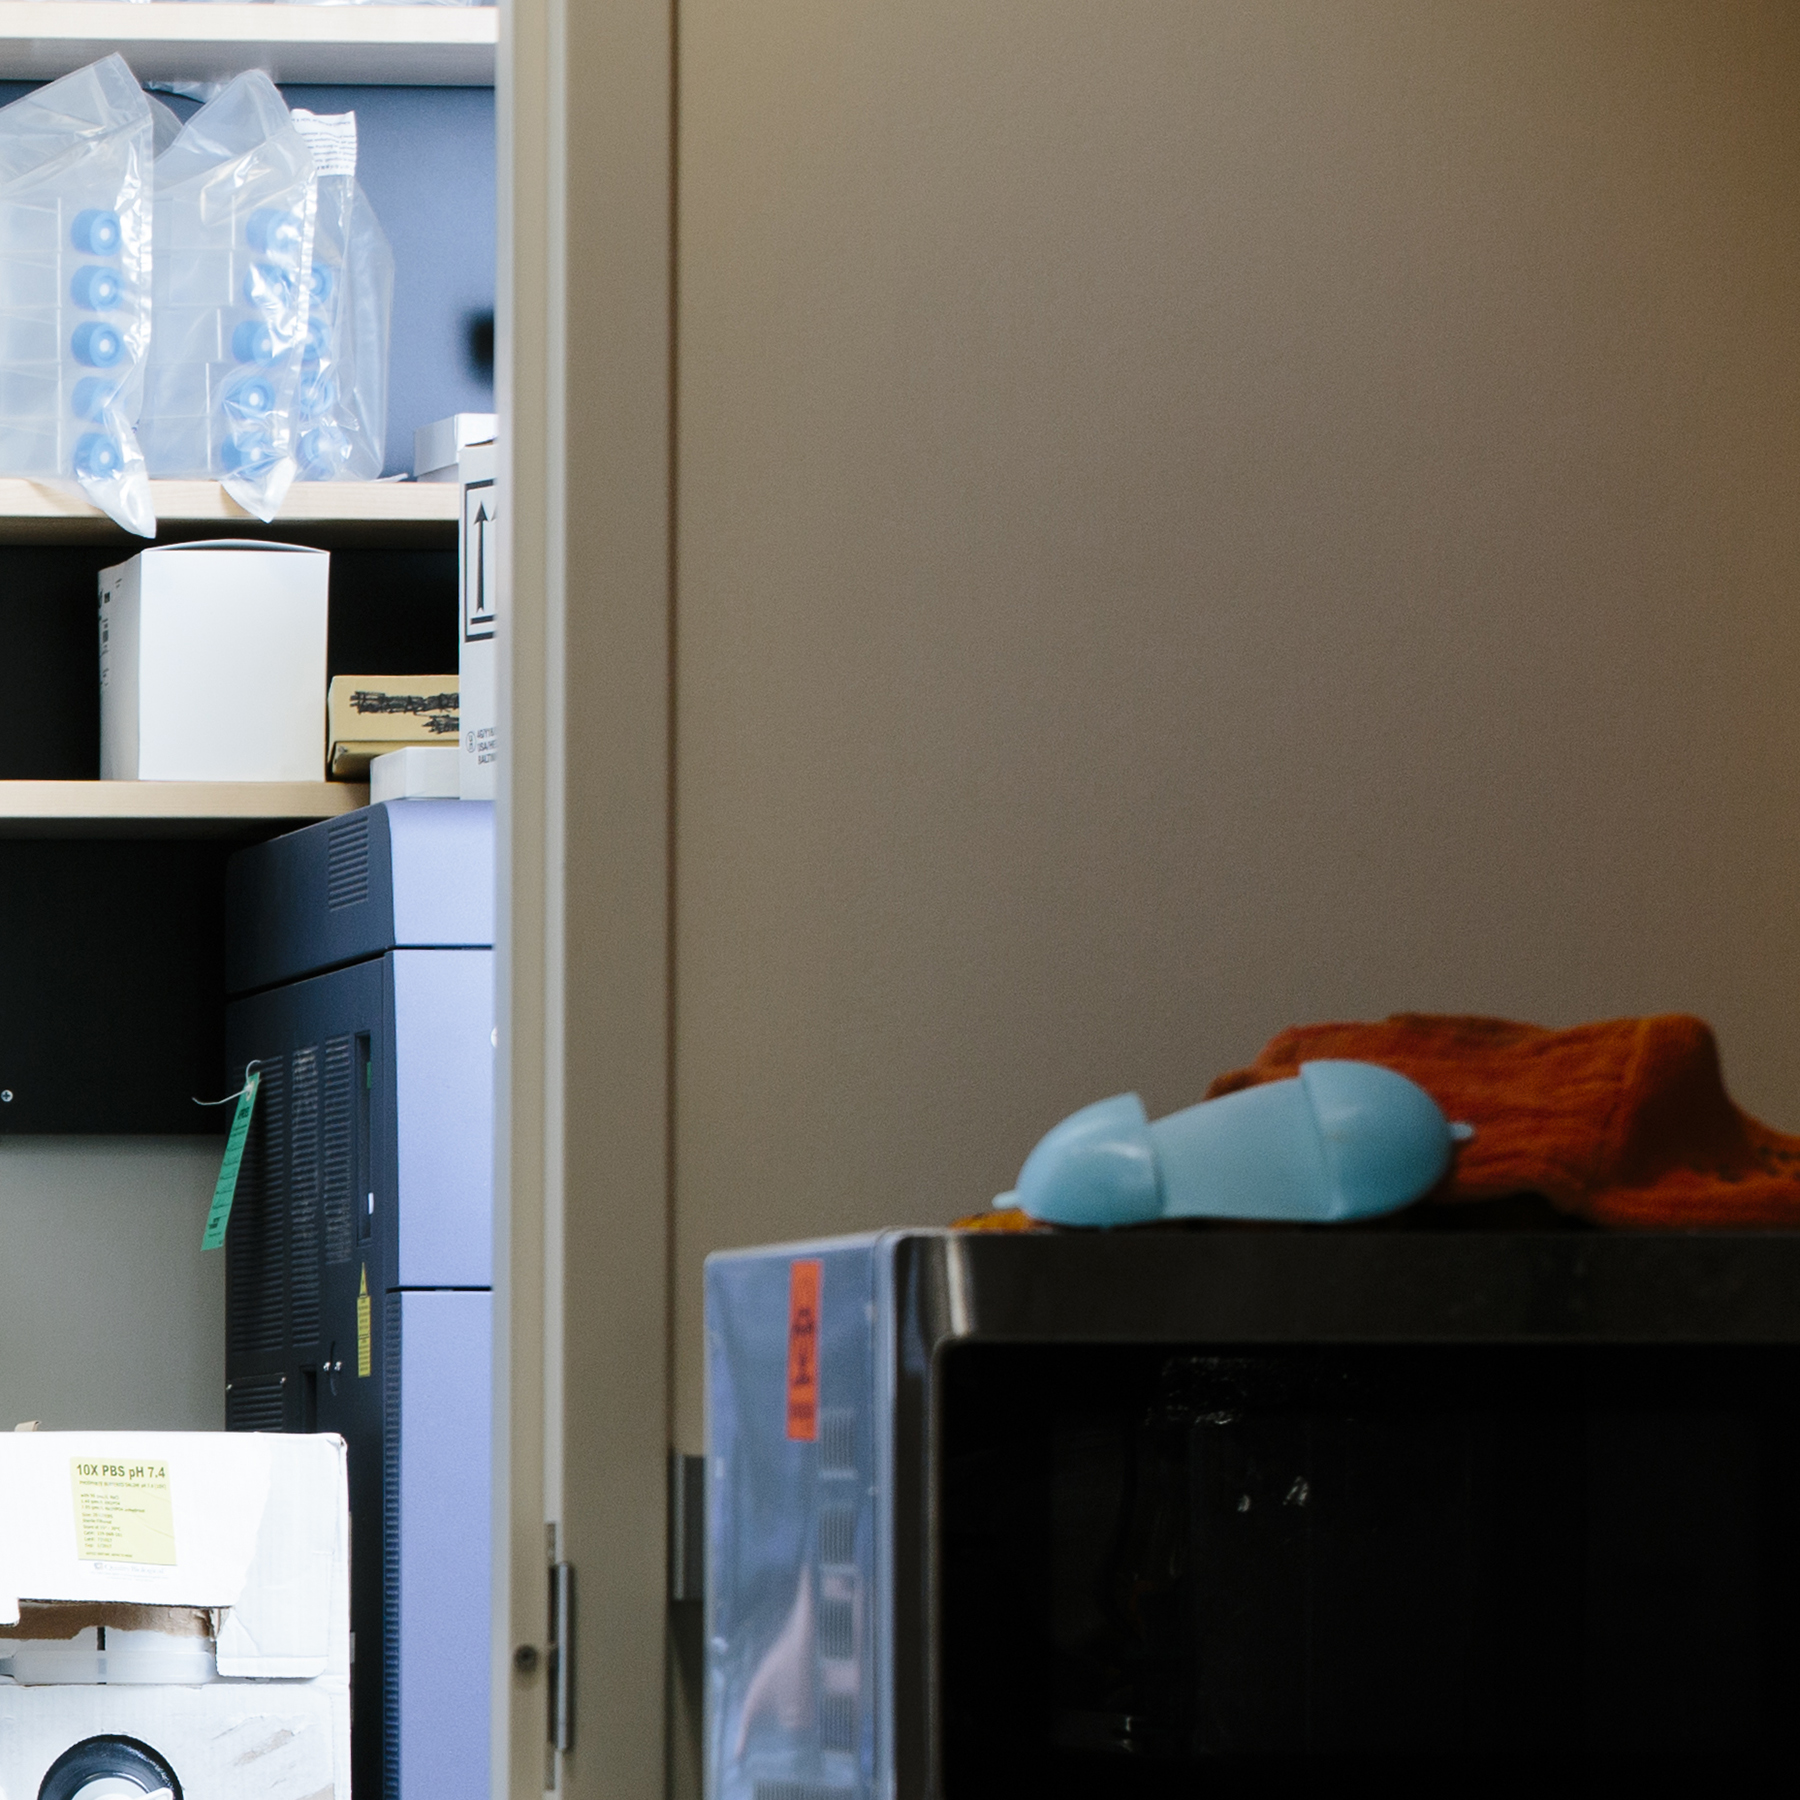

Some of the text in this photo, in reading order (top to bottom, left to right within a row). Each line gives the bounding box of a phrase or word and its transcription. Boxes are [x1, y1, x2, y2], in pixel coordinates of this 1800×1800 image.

[76, 1463, 166, 1480] 10X PBS pH 7.4
